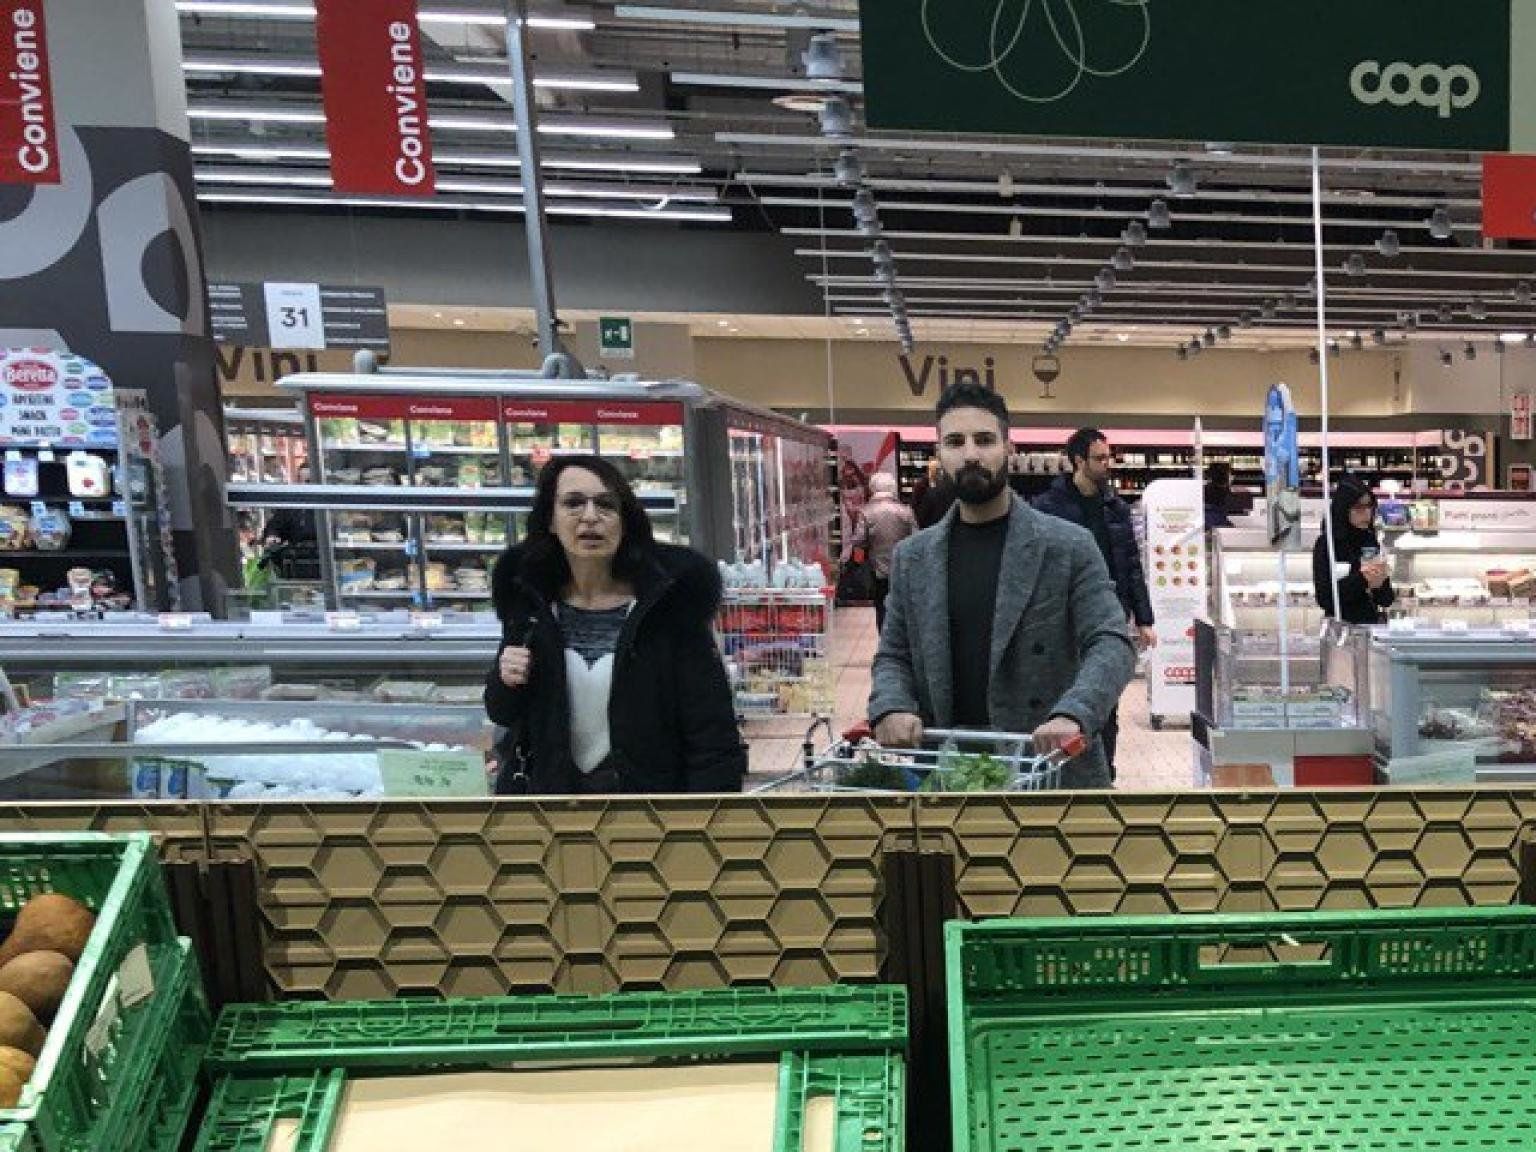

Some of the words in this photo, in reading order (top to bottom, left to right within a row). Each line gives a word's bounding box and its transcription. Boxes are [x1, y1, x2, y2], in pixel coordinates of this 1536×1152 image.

[9, 8, 49, 174] Conviene
[385, 21, 426, 186] Conviene
[1350, 59, 1481, 118] coop
[280, 306, 309, 328] 31
[898, 355, 995, 397] Vini
